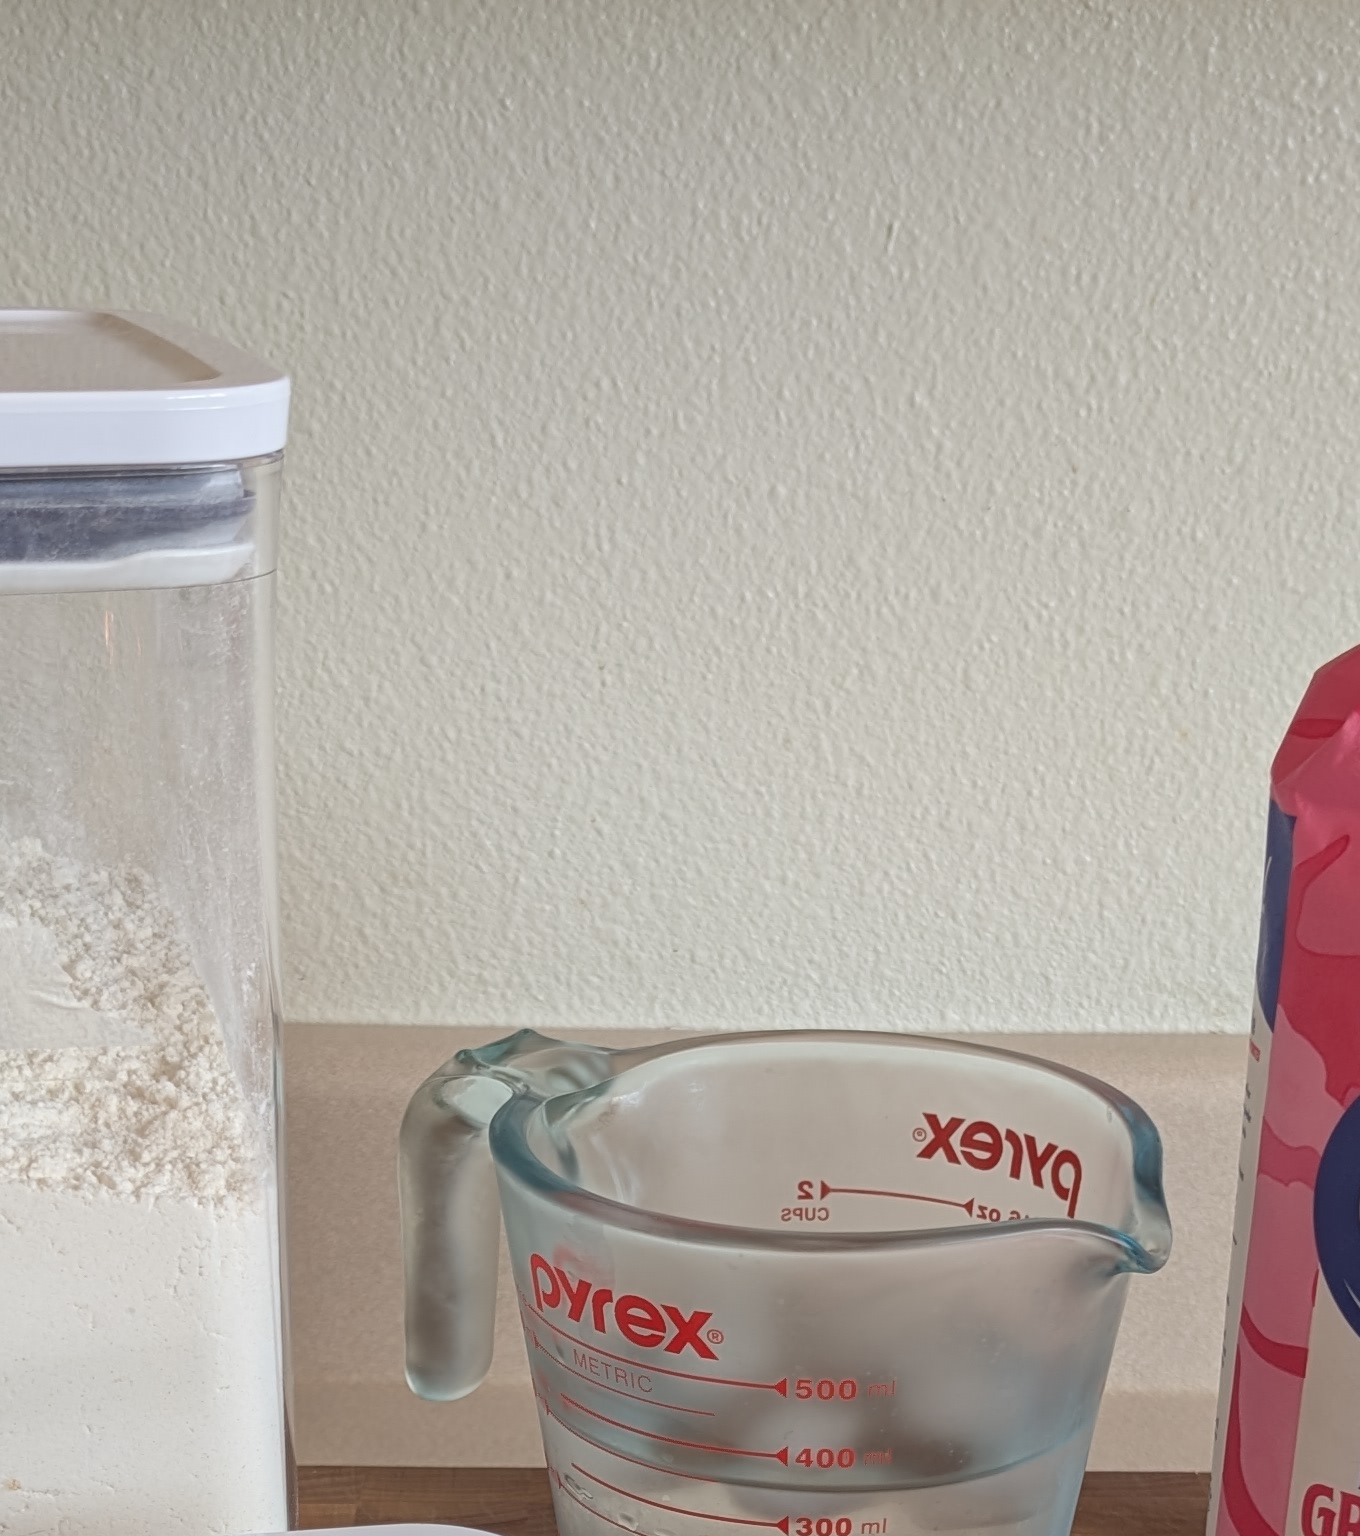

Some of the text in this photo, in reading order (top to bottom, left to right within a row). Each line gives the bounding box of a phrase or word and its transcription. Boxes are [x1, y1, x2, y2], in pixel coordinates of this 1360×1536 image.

[529, 1252, 719, 1361] pyrex
[574, 1349, 653, 1393] METRIC
[795, 1379, 895, 1400] 500 ml
[795, 1448, 856, 1468] 400
[795, 1517, 887, 1536] 300 ml
